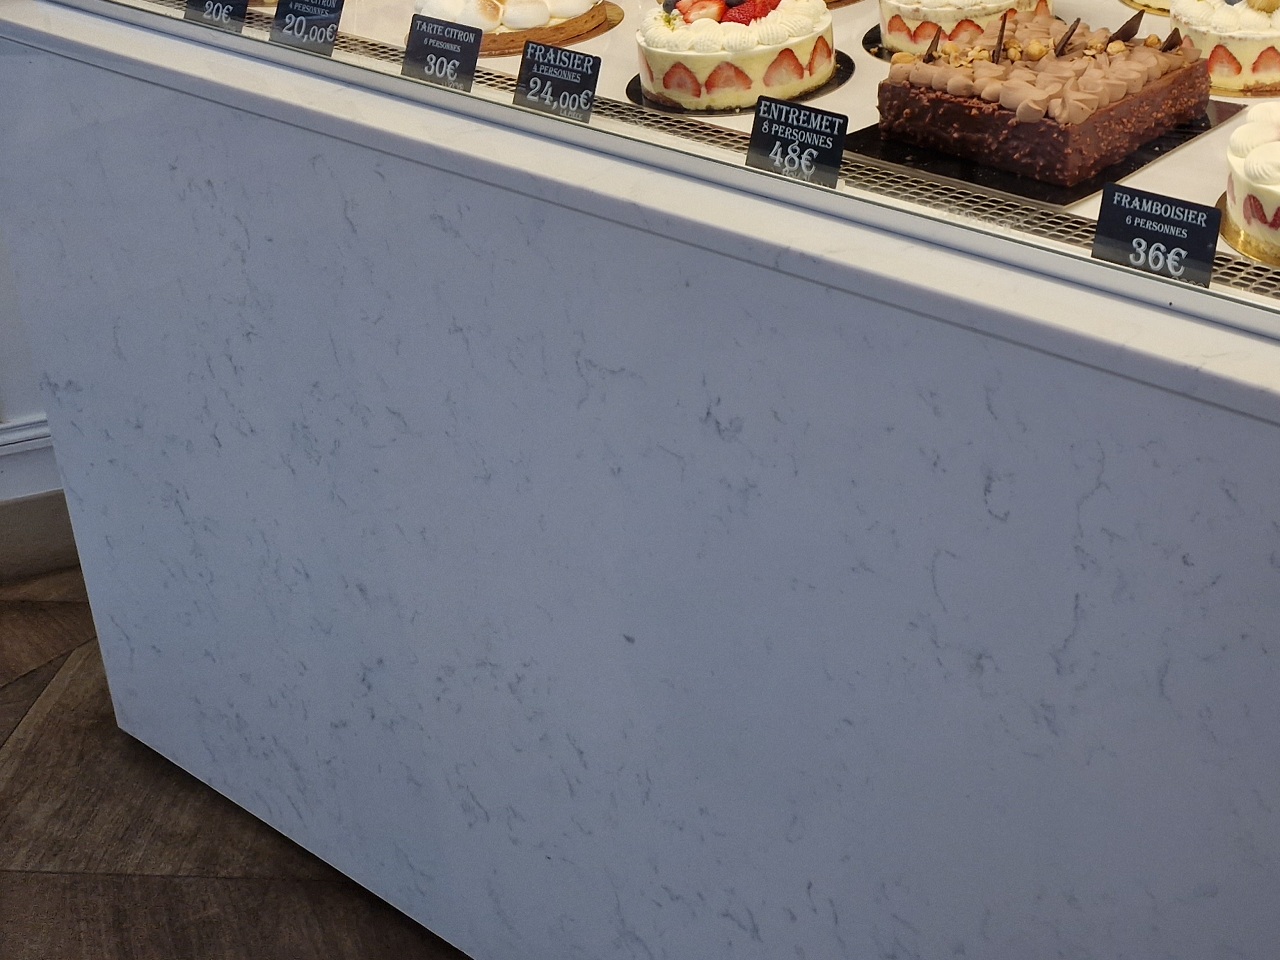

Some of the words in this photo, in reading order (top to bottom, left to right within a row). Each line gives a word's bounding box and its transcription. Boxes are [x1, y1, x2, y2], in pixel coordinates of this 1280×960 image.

[203, 0, 234, 23] 20€
[294, 2, 330, 17] PERSONNES
[282, 13, 338, 44] 20,00€
[416, 21, 444, 36] TARTE
[445, 27, 476, 43] CITRON
[429, 38, 461, 53] PERSONNES
[526, 42, 594, 75] FRAISIER
[424, 54, 460, 81] 30€
[540, 64, 581, 82] PERSONNES
[526, 77, 593, 112] 24,00€
[759, 100, 843, 135] ENTREMET
[761, 120, 769, 133] 8
[771, 123, 833, 149] PERSONNES
[769, 140, 819, 175] 48€
[1113, 192, 1208, 228] FRAMBOISIER
[1125, 215, 1132, 225] 6
[1133, 217, 1188, 239] PERSONNES
[1129, 237, 1188, 277] 36€
